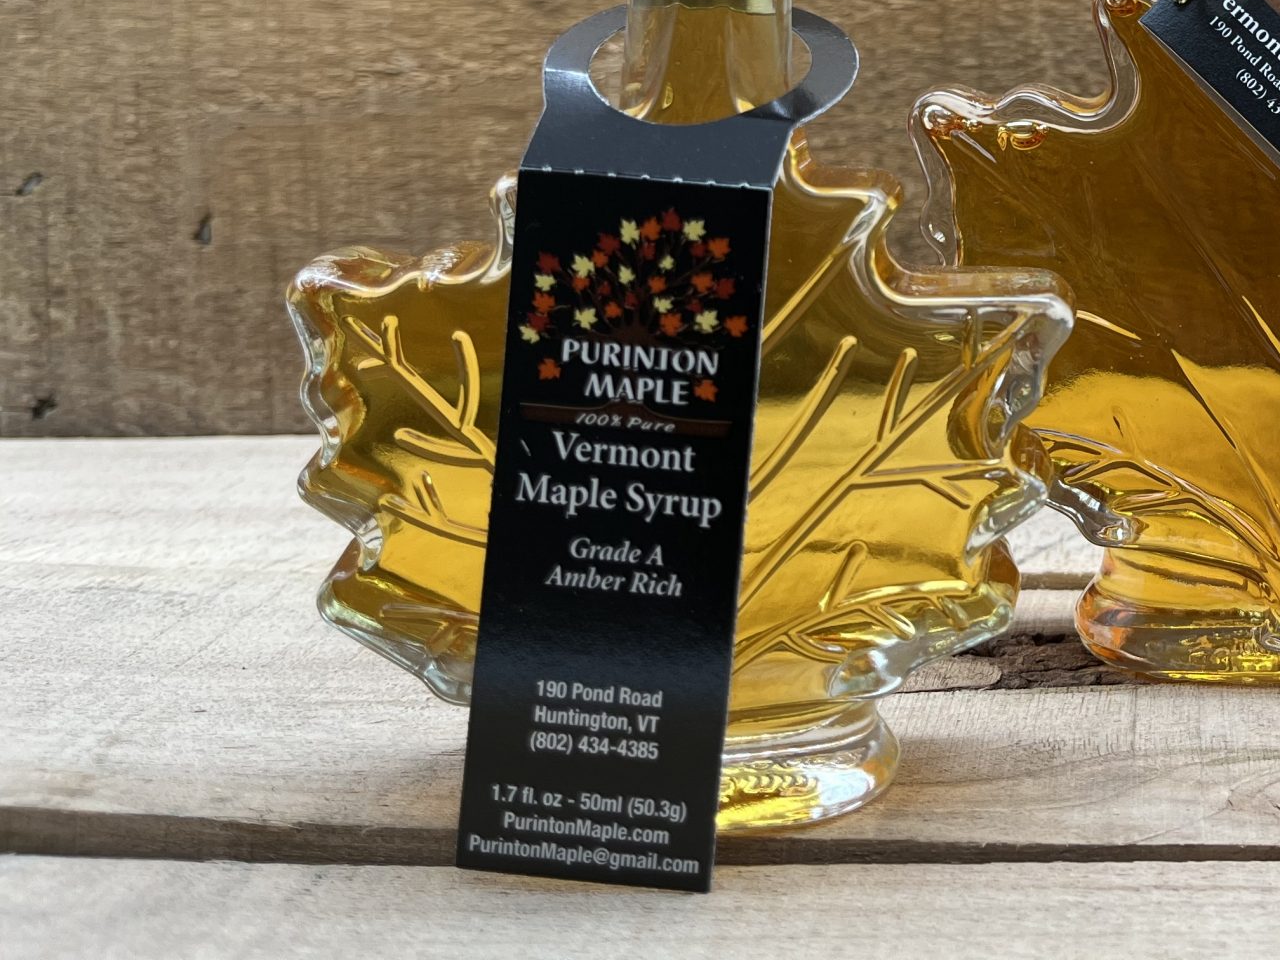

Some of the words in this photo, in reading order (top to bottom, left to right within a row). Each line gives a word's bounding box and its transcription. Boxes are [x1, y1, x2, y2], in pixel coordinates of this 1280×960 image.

[1209, 16, 1233, 38] 190
[1230, 35, 1263, 67] Pond
[1235, 68, 1267, 100] (802)
[561, 338, 719, 376] PURINTON
[584, 373, 689, 405] MAPLE
[575, 413, 623, 427] 100%
[627, 417, 676, 433] Pure
[552, 431, 696, 472] Vermont
[515, 472, 617, 518] Maple
[625, 482, 722, 528] Syrup
[569, 537, 641, 564] Grade
[646, 545, 664, 566] A
[545, 565, 624, 592] Amber
[629, 569, 683, 597] Rich
[536, 680, 567, 698] 190
[572, 683, 615, 703] Pond
[619, 687, 663, 708] Road
[534, 705, 632, 734] Huntington,
[638, 715, 660, 733] VT
[530, 731, 573, 754] (802)
[578, 737, 659, 760] 434-4385
[492, 784, 517, 803] 1.7
[522, 787, 537, 804] fl.
[543, 793, 562, 807] oz
[580, 793, 622, 813] 50ml
[627, 796, 687, 823] (50.3g)
[503, 811, 670, 845] PurintonMaple.com
[469, 834, 699, 874] PurintonMaple@gmail.com
